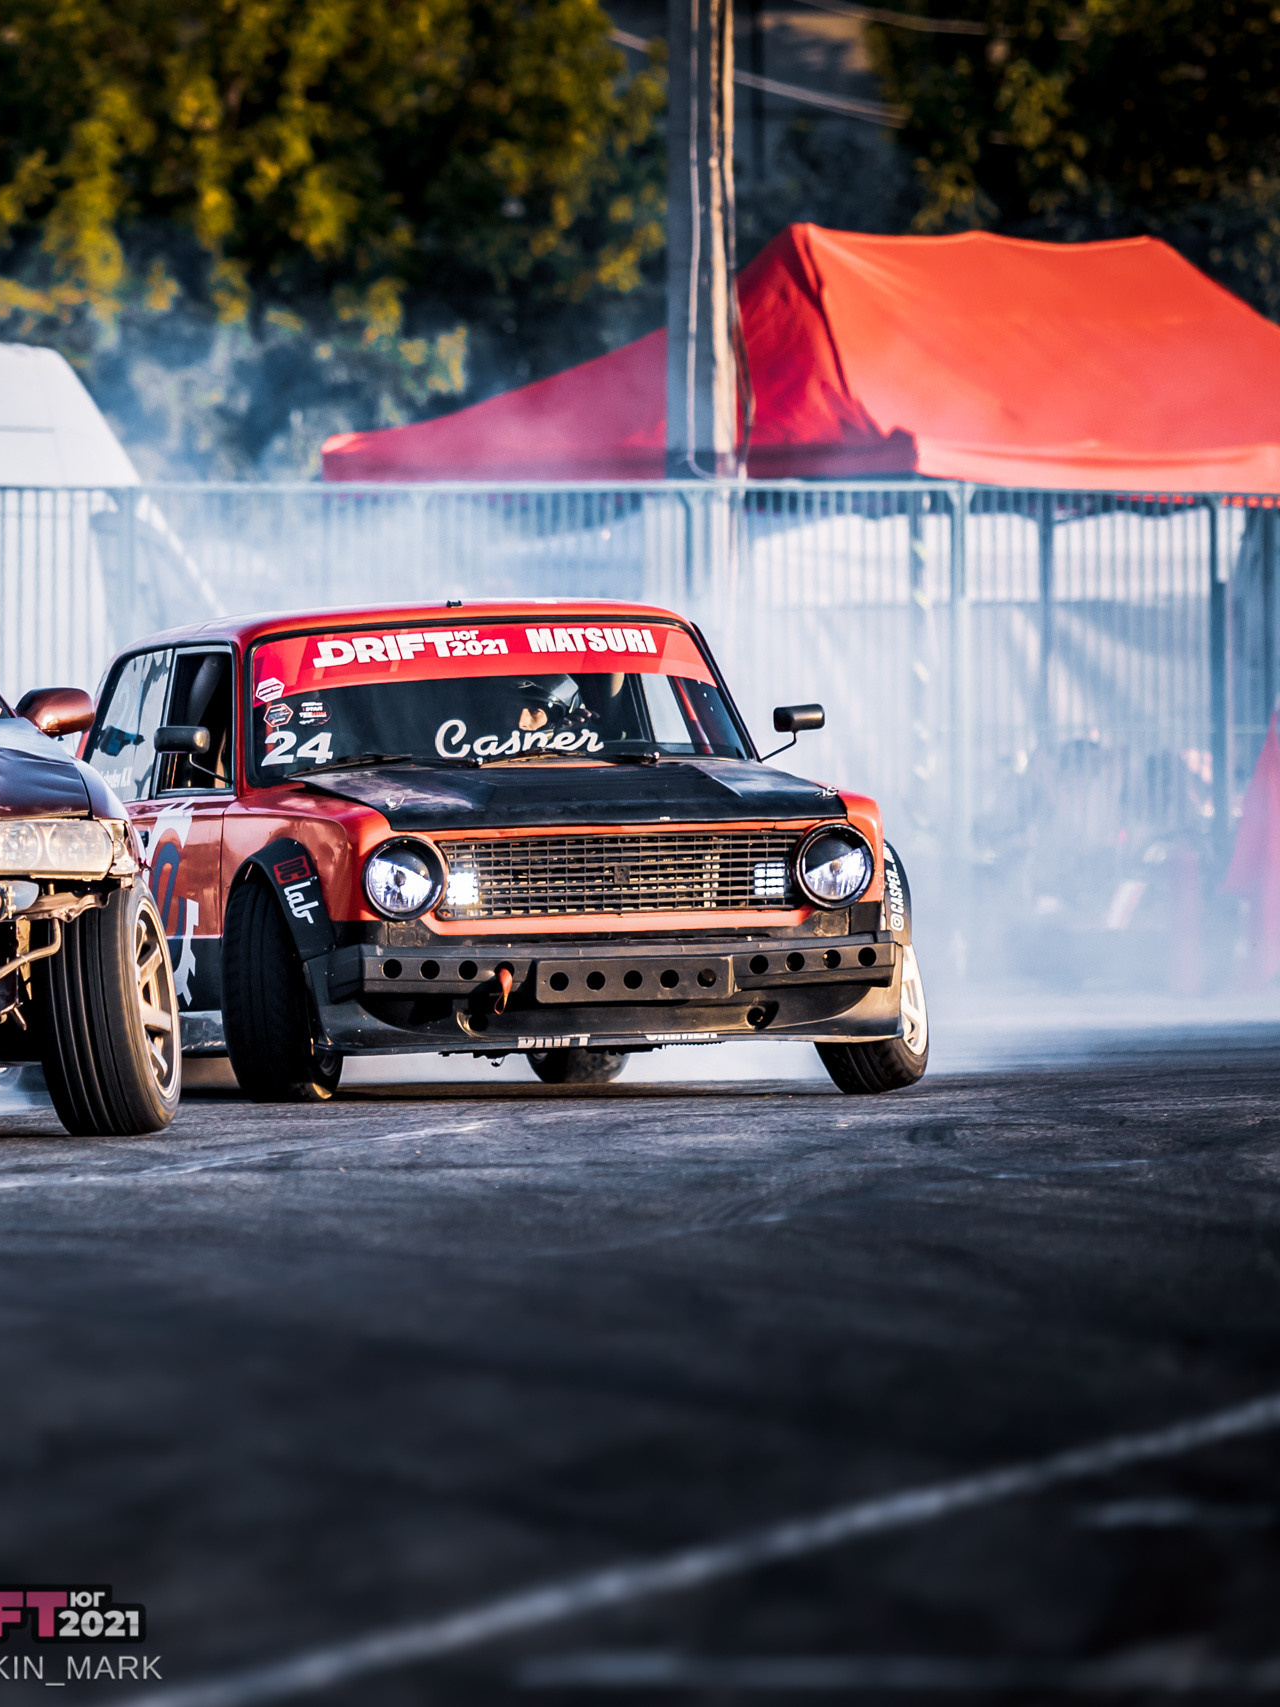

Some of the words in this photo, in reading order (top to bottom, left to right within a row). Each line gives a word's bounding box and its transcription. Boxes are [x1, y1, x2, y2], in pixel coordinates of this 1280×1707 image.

[312, 631, 455, 668] DRIFT
[448, 638, 509, 657] 2021
[524, 627, 658, 654] MATSURI
[260, 731, 334, 767] 24
